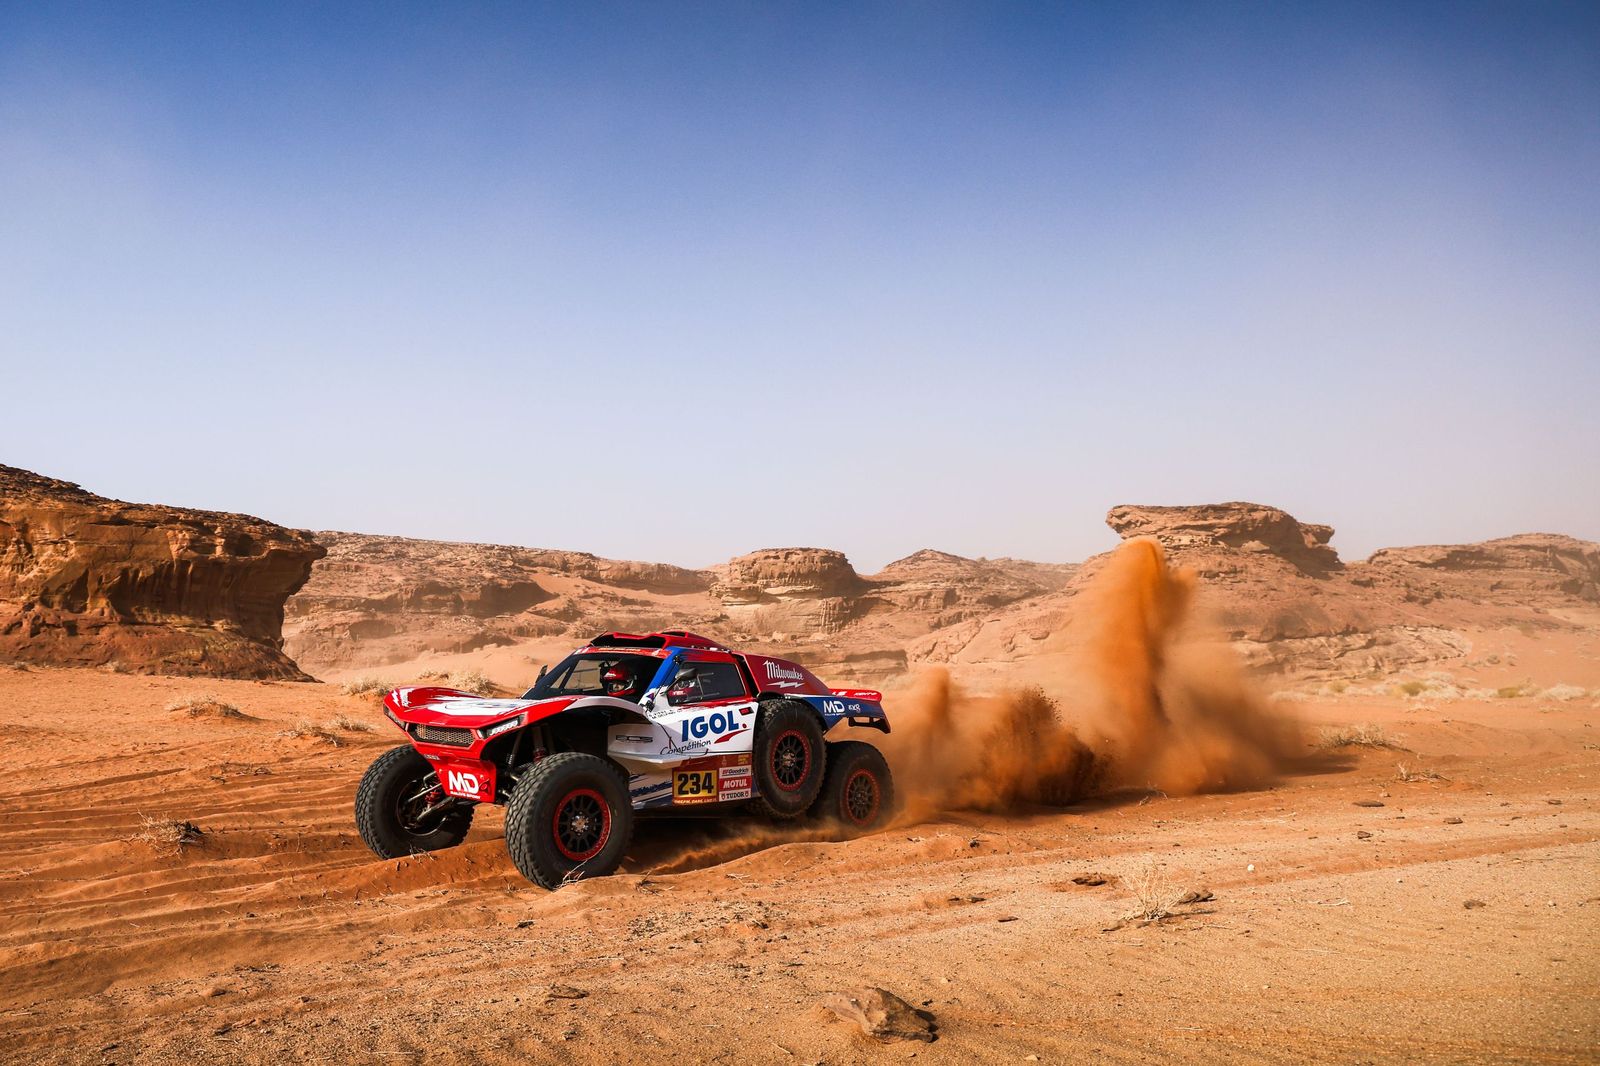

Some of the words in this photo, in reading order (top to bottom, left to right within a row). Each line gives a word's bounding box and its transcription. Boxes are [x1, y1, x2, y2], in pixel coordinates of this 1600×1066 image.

[763, 660, 804, 680] Milwaukee
[823, 700, 845, 713] MD
[681, 711, 739, 742] IGOL
[660, 740, 711, 755] Compétition
[448, 770, 479, 794] MD
[677, 772, 714, 795] 234
[723, 779, 747, 789] MOTUL
[726, 791, 744, 799] TUDOR
